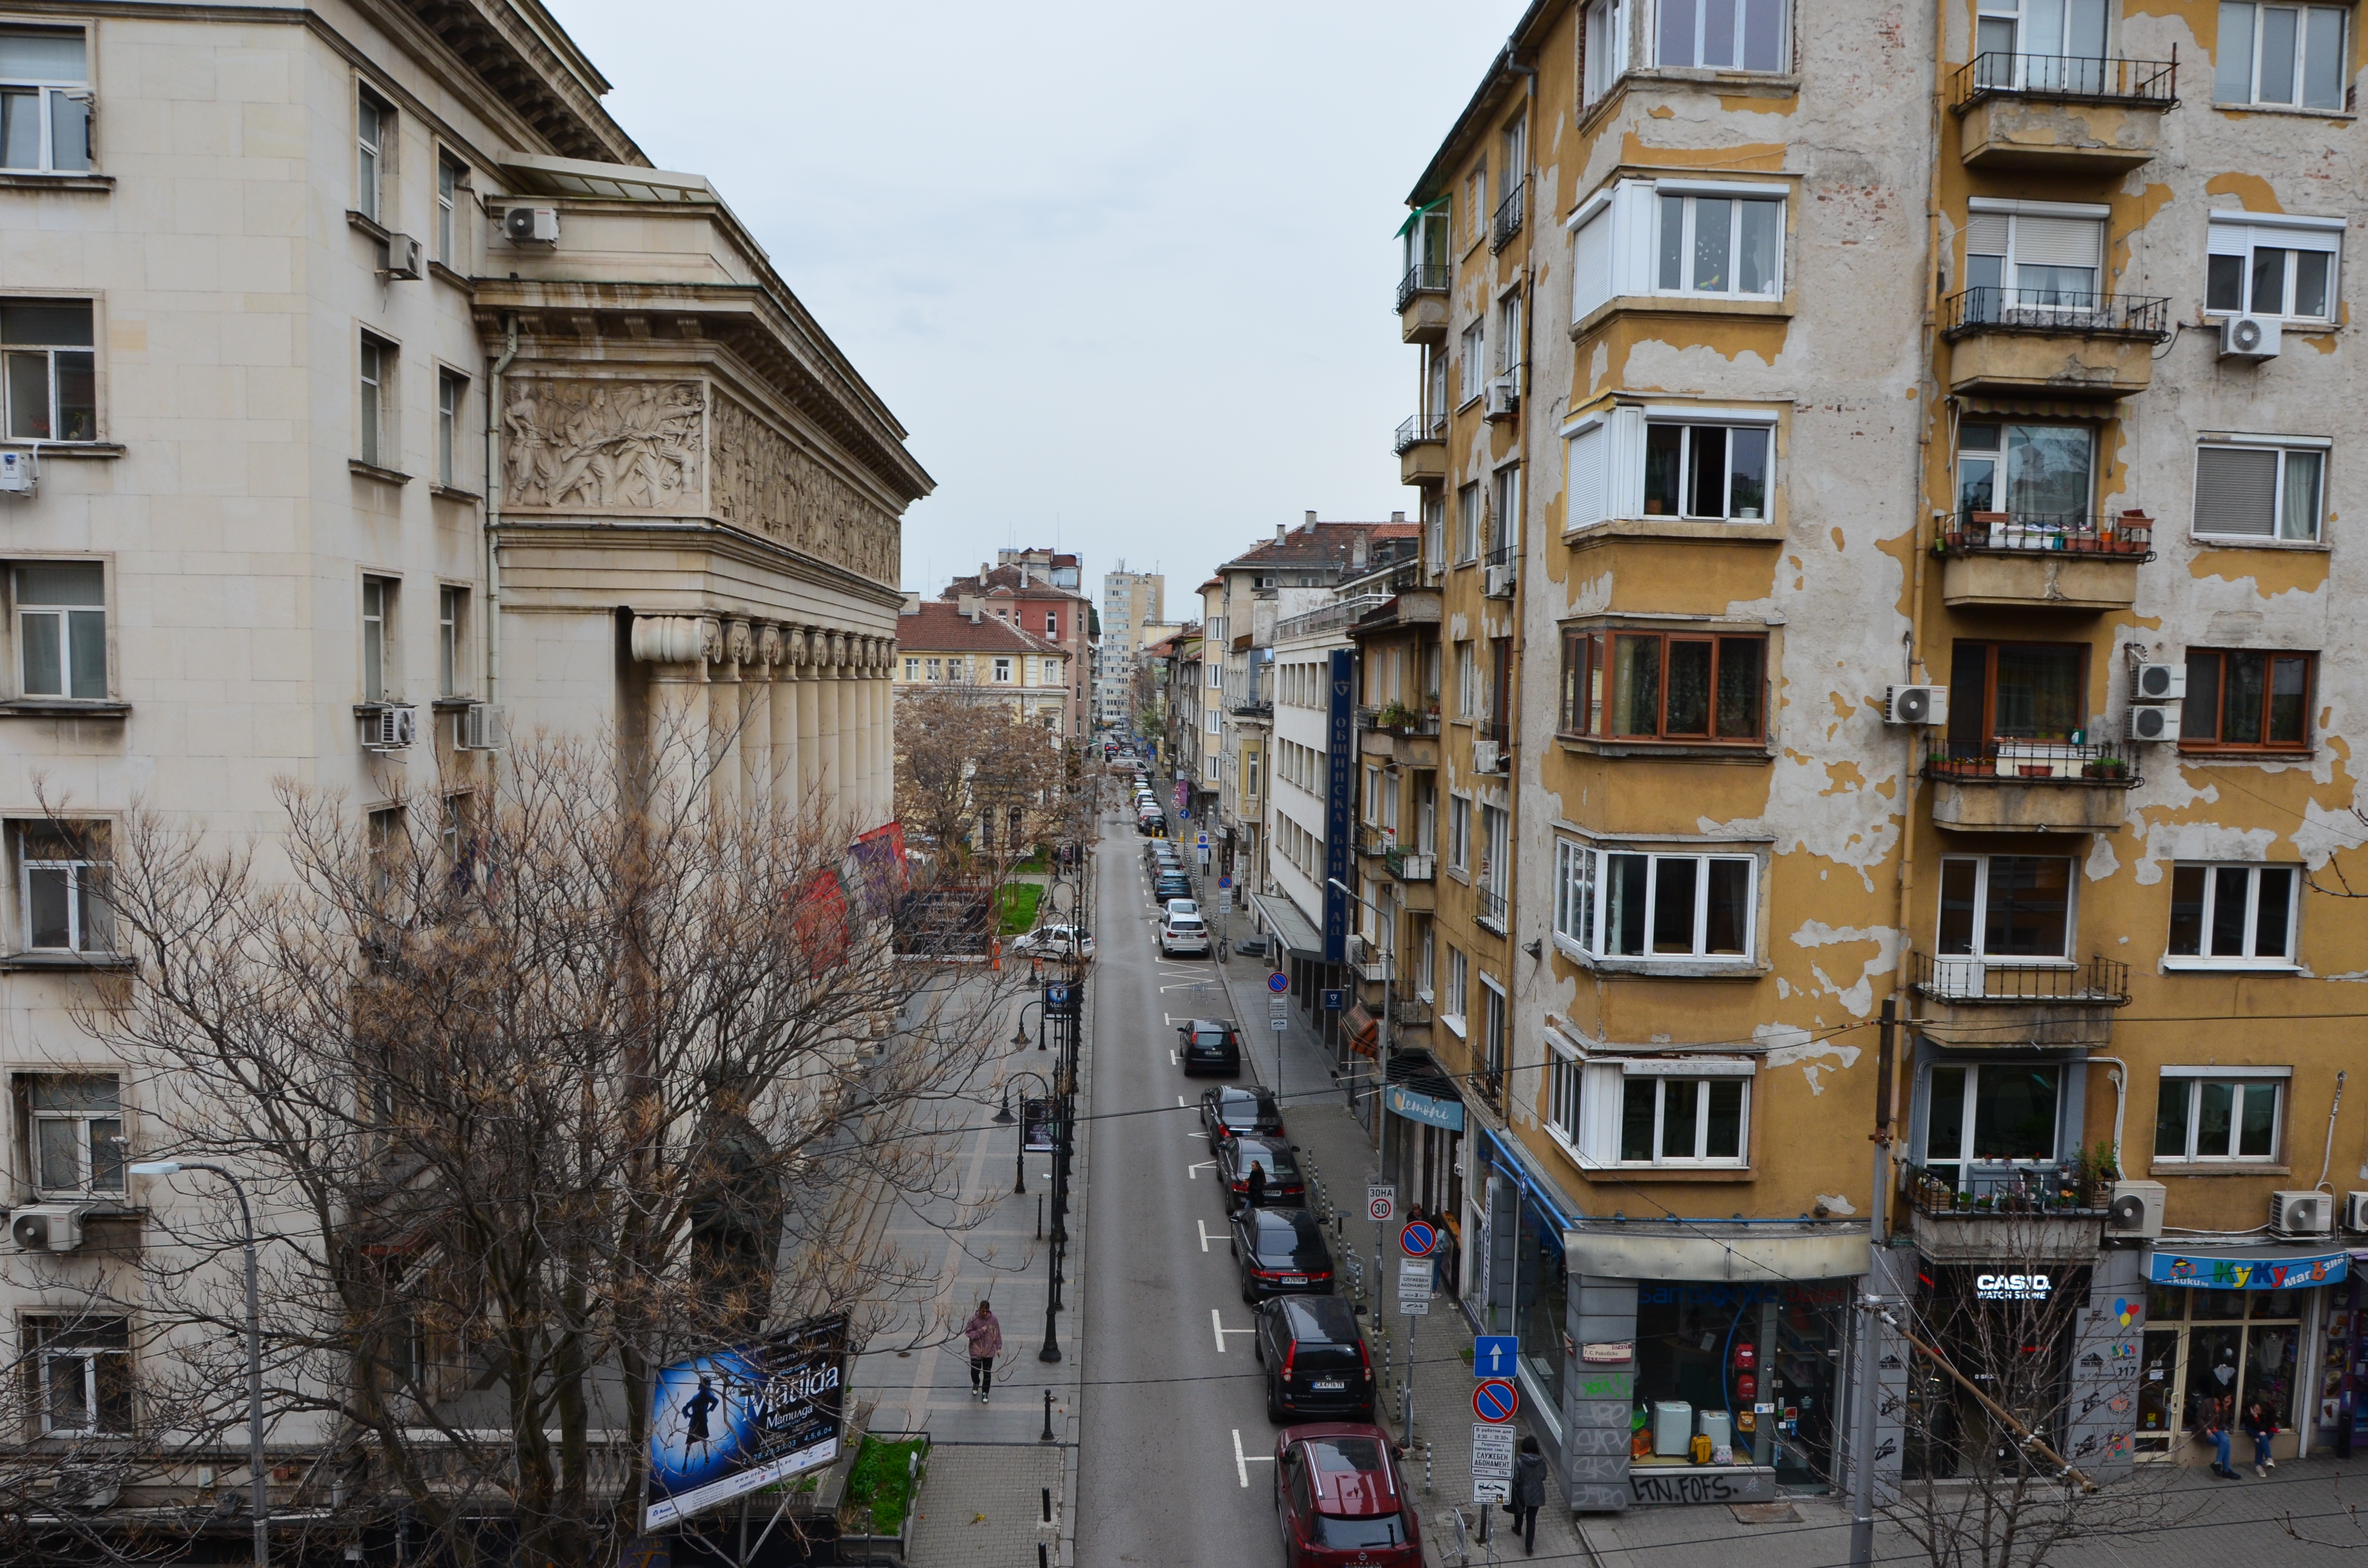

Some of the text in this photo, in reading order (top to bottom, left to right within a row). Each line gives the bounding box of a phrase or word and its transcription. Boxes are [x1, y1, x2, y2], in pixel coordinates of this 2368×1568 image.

[1333, 717, 1348, 822] ОБЩИНСКА
[1330, 912, 1342, 936] АД
[1400, 1093, 1449, 1119] Lemoni
[1433, 1117, 1458, 1127] bistrot
[1374, 1203, 1387, 1214] 30
[1977, 1275, 2049, 1290] CASIO
[1786, 1286, 1844, 1302] Outlet
[1977, 1291, 2012, 1299] WATCH
[2118, 1367, 2137, 1376] 117
[742, 1361, 839, 1422] Matilda
[766, 1405, 813, 1430] Матилда
[1477, 1452, 1508, 1461] СЛУЖЕБЕН
[1474, 1460, 1510, 1468] АБОНАМЕНТ
[739, 1480, 755, 1488] eventim
